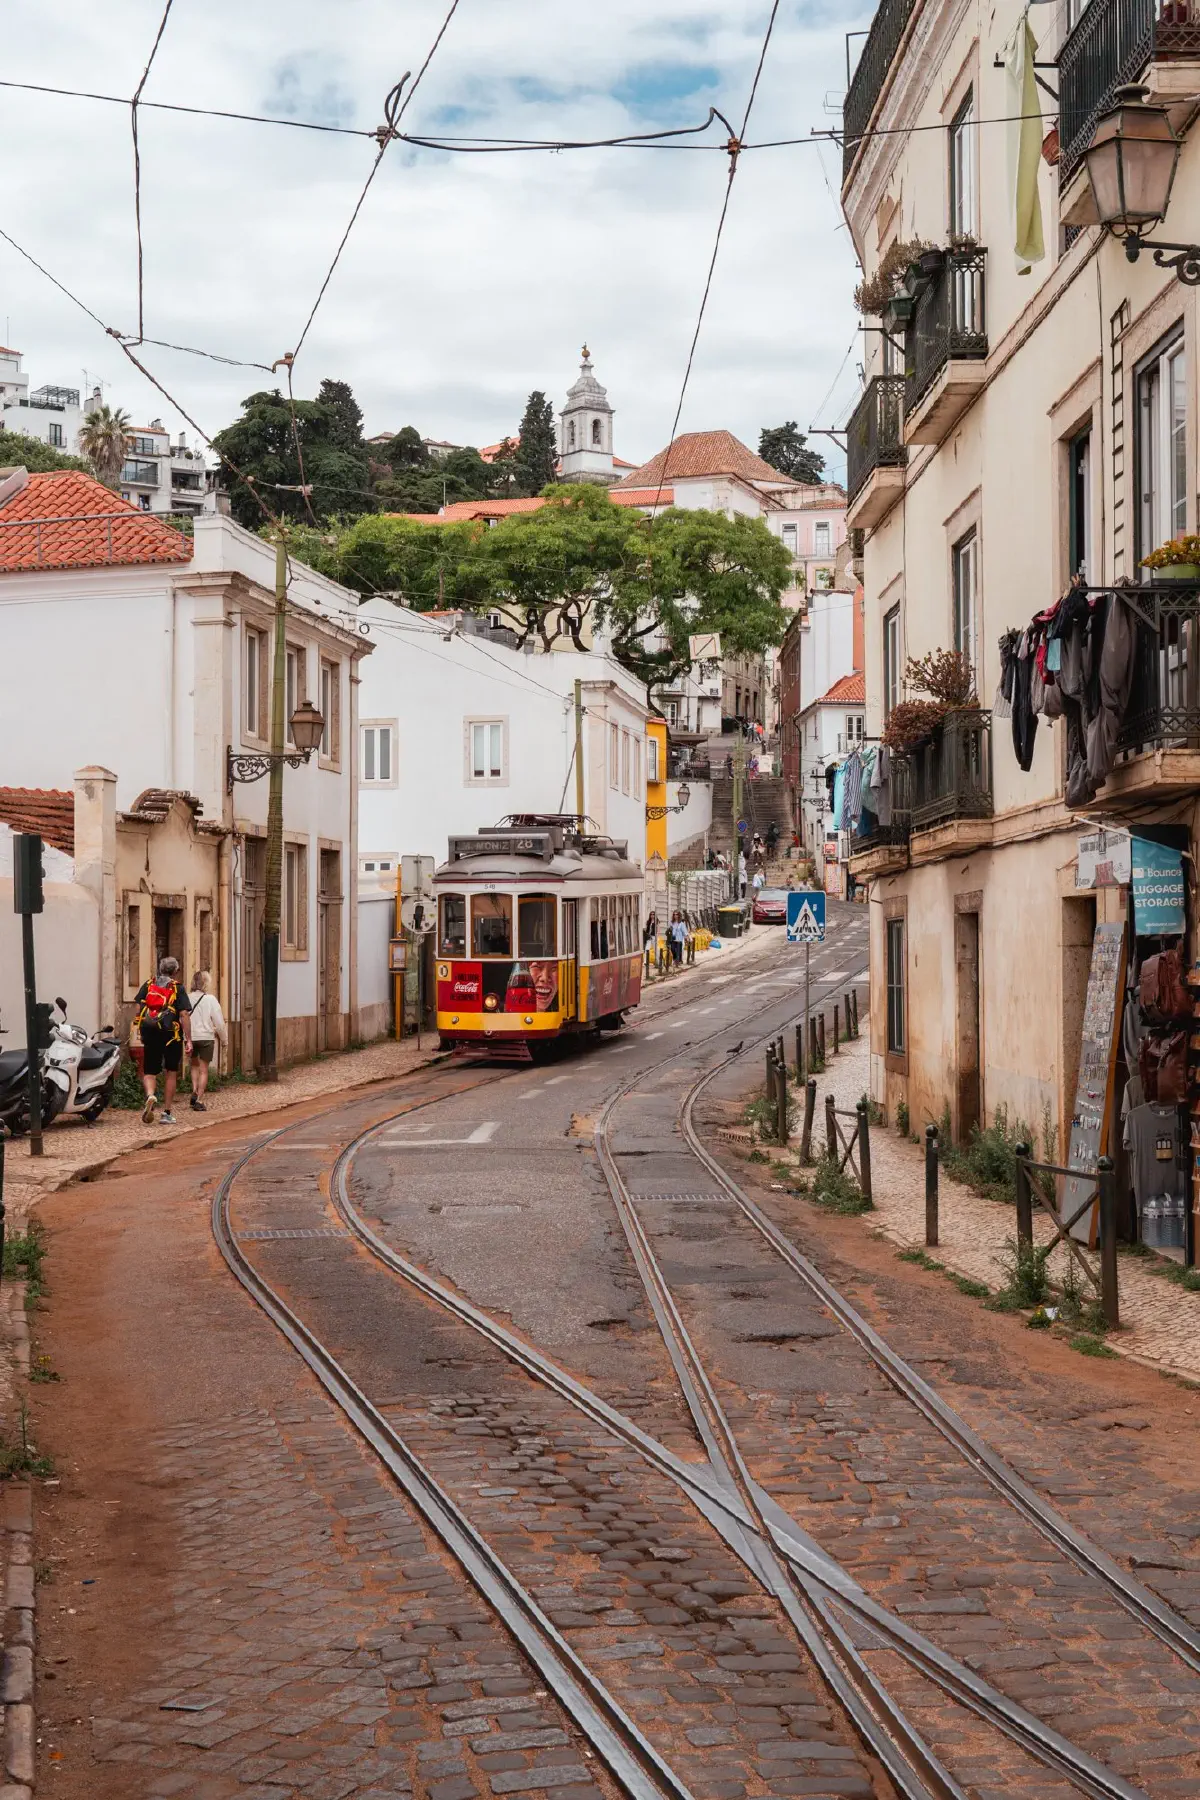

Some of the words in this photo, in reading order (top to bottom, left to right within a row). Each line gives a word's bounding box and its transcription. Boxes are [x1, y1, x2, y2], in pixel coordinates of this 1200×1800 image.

[476, 841, 509, 850] MONIZ
[517, 839, 533, 849] 28
[1147, 868, 1182, 877] Bounce
[1133, 884, 1184, 895] LUGGAGE
[1134, 897, 1184, 908] STORAGE
